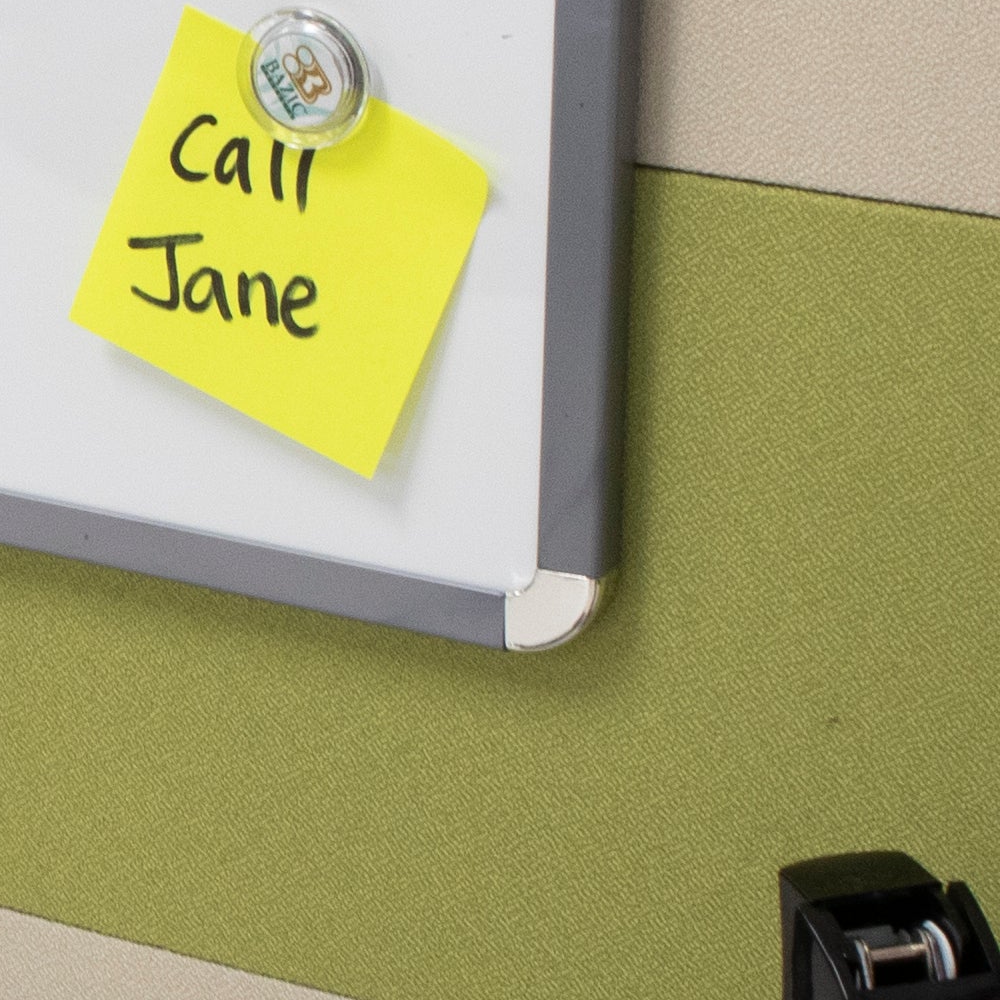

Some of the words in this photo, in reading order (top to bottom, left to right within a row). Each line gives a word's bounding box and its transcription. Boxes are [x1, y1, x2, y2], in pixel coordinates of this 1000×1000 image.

[260, 58, 308, 119] BAZIC
[168, 113, 317, 215] Call
[127, 232, 319, 339] Jane
